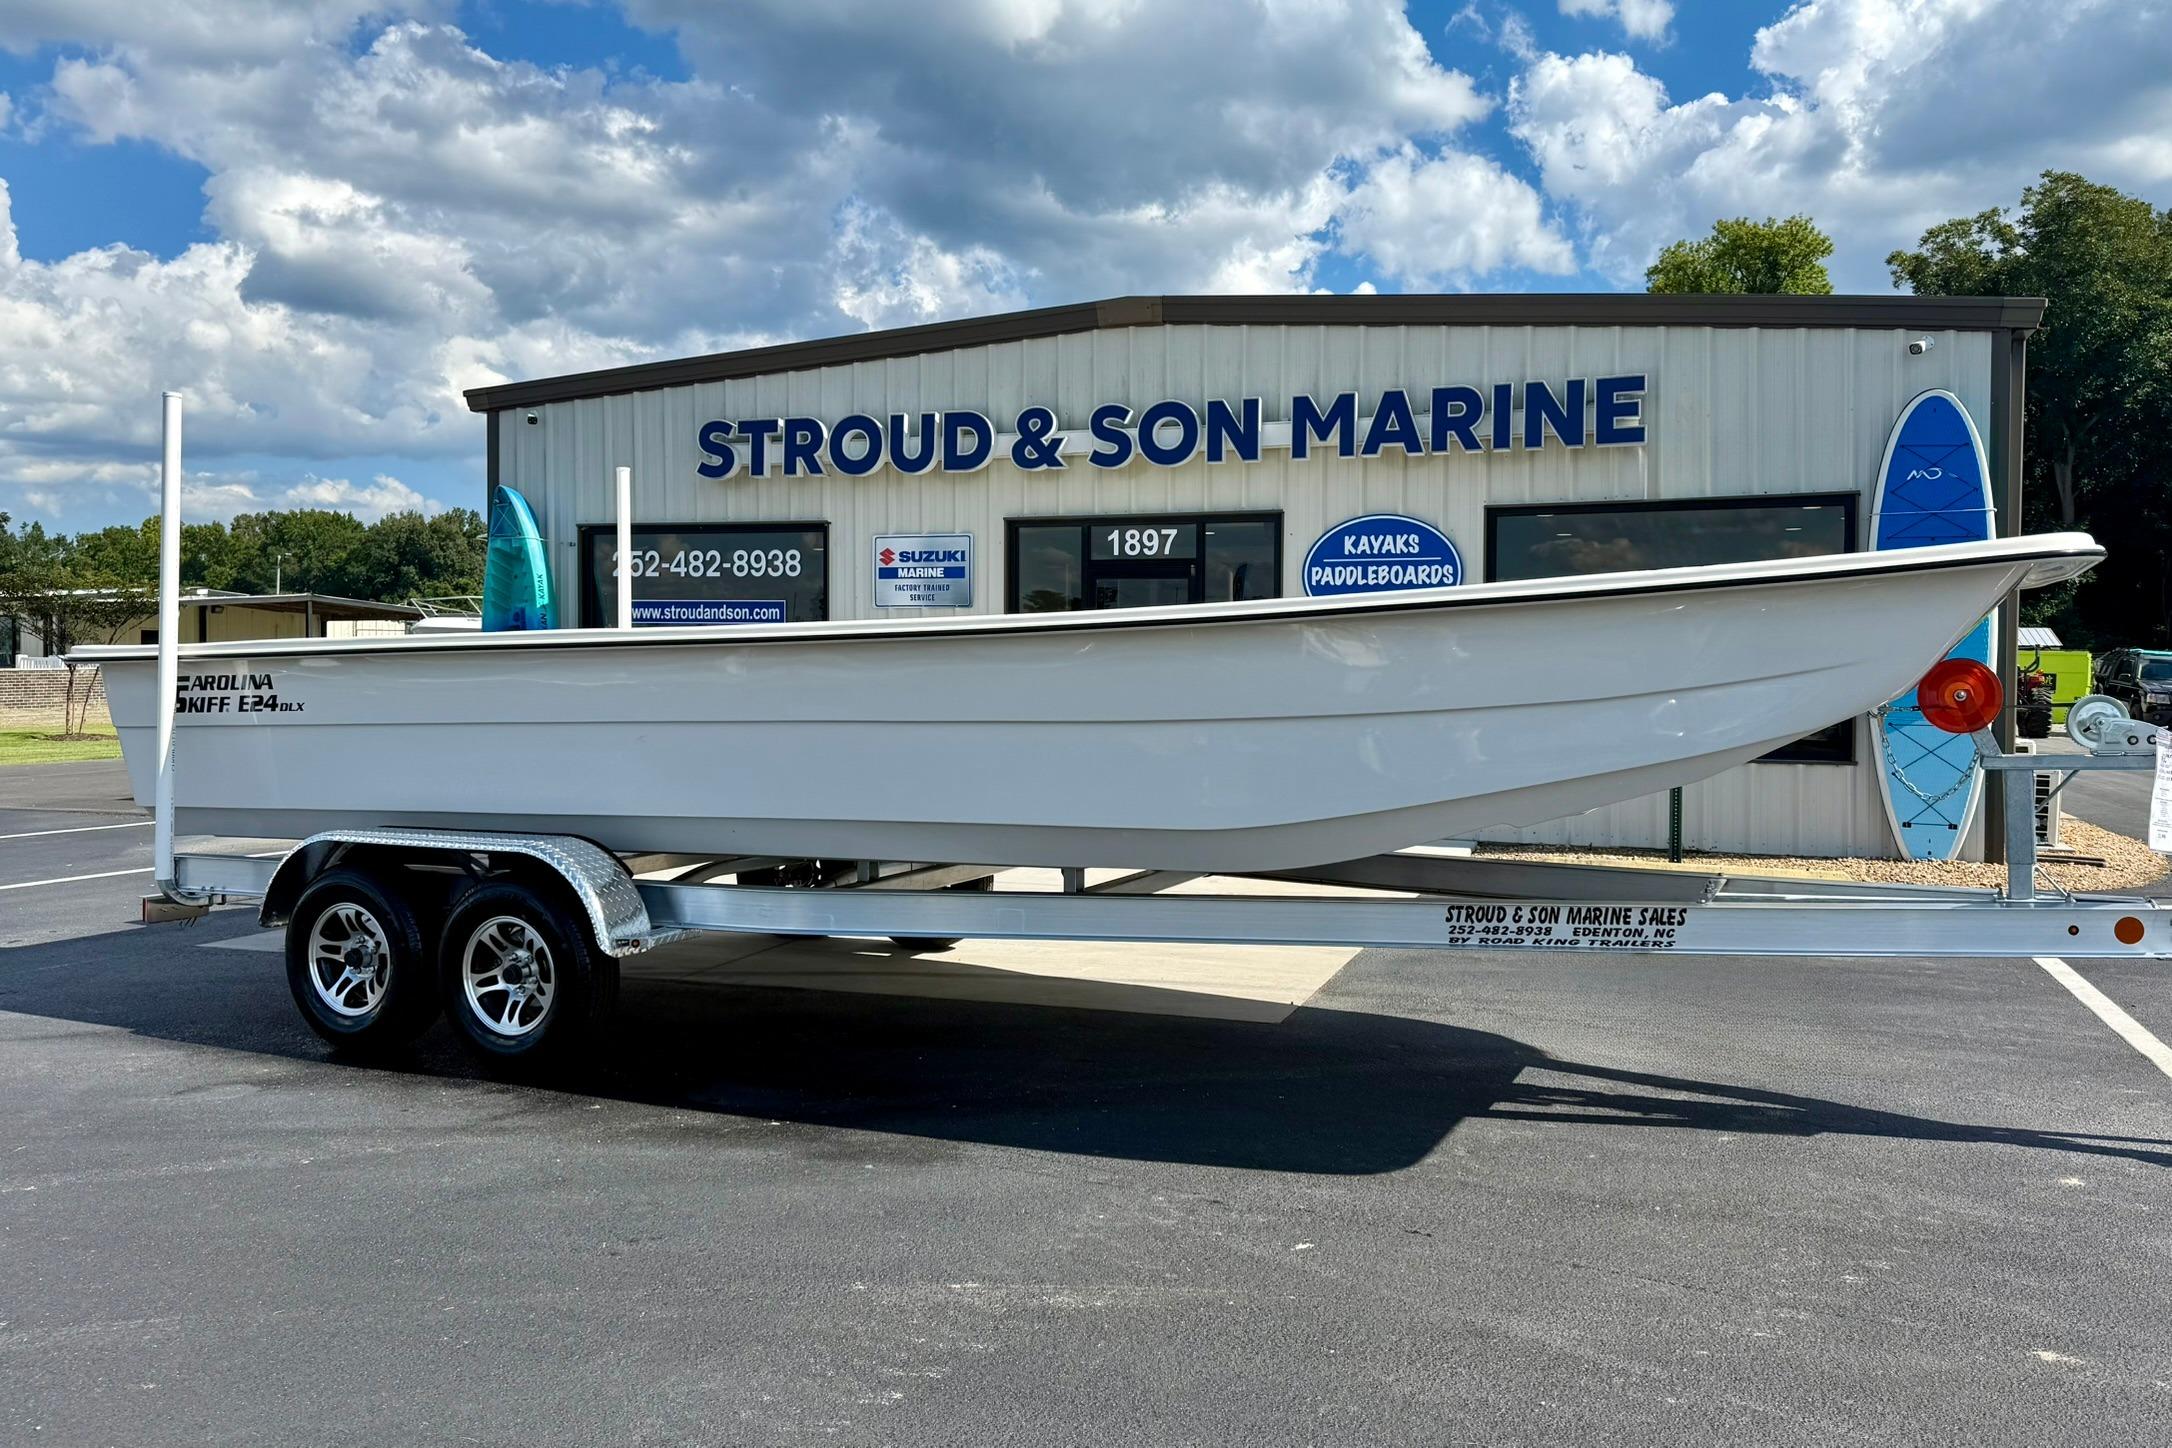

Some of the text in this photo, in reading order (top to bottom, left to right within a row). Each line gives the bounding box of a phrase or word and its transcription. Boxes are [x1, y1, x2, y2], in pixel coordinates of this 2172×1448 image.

[697, 373, 1648, 480] STROUD & SON MARINE
[1107, 528, 1178, 556] 1897
[1344, 533, 1420, 556] KAYAKS
[898, 549, 967, 563] SUZUKI
[897, 567, 945, 578] MARINE
[1311, 564, 1454, 587] PADDLEBOARDS
[894, 584, 950, 592] FACTORY TRAINED
[909, 593, 935, 602] SERVICE
[631, 603, 781, 620] www.stroudandson.com
[238, 695, 278, 712] E24
[279, 702, 305, 712] DLX
[1445, 905, 1687, 926] STROUD & SON MARINE SALES
[1448, 925, 1676, 939] 252-482-8938 EDENTON, NC
[1448, 937, 1676, 948] BY ROAD KING TRAILERS
